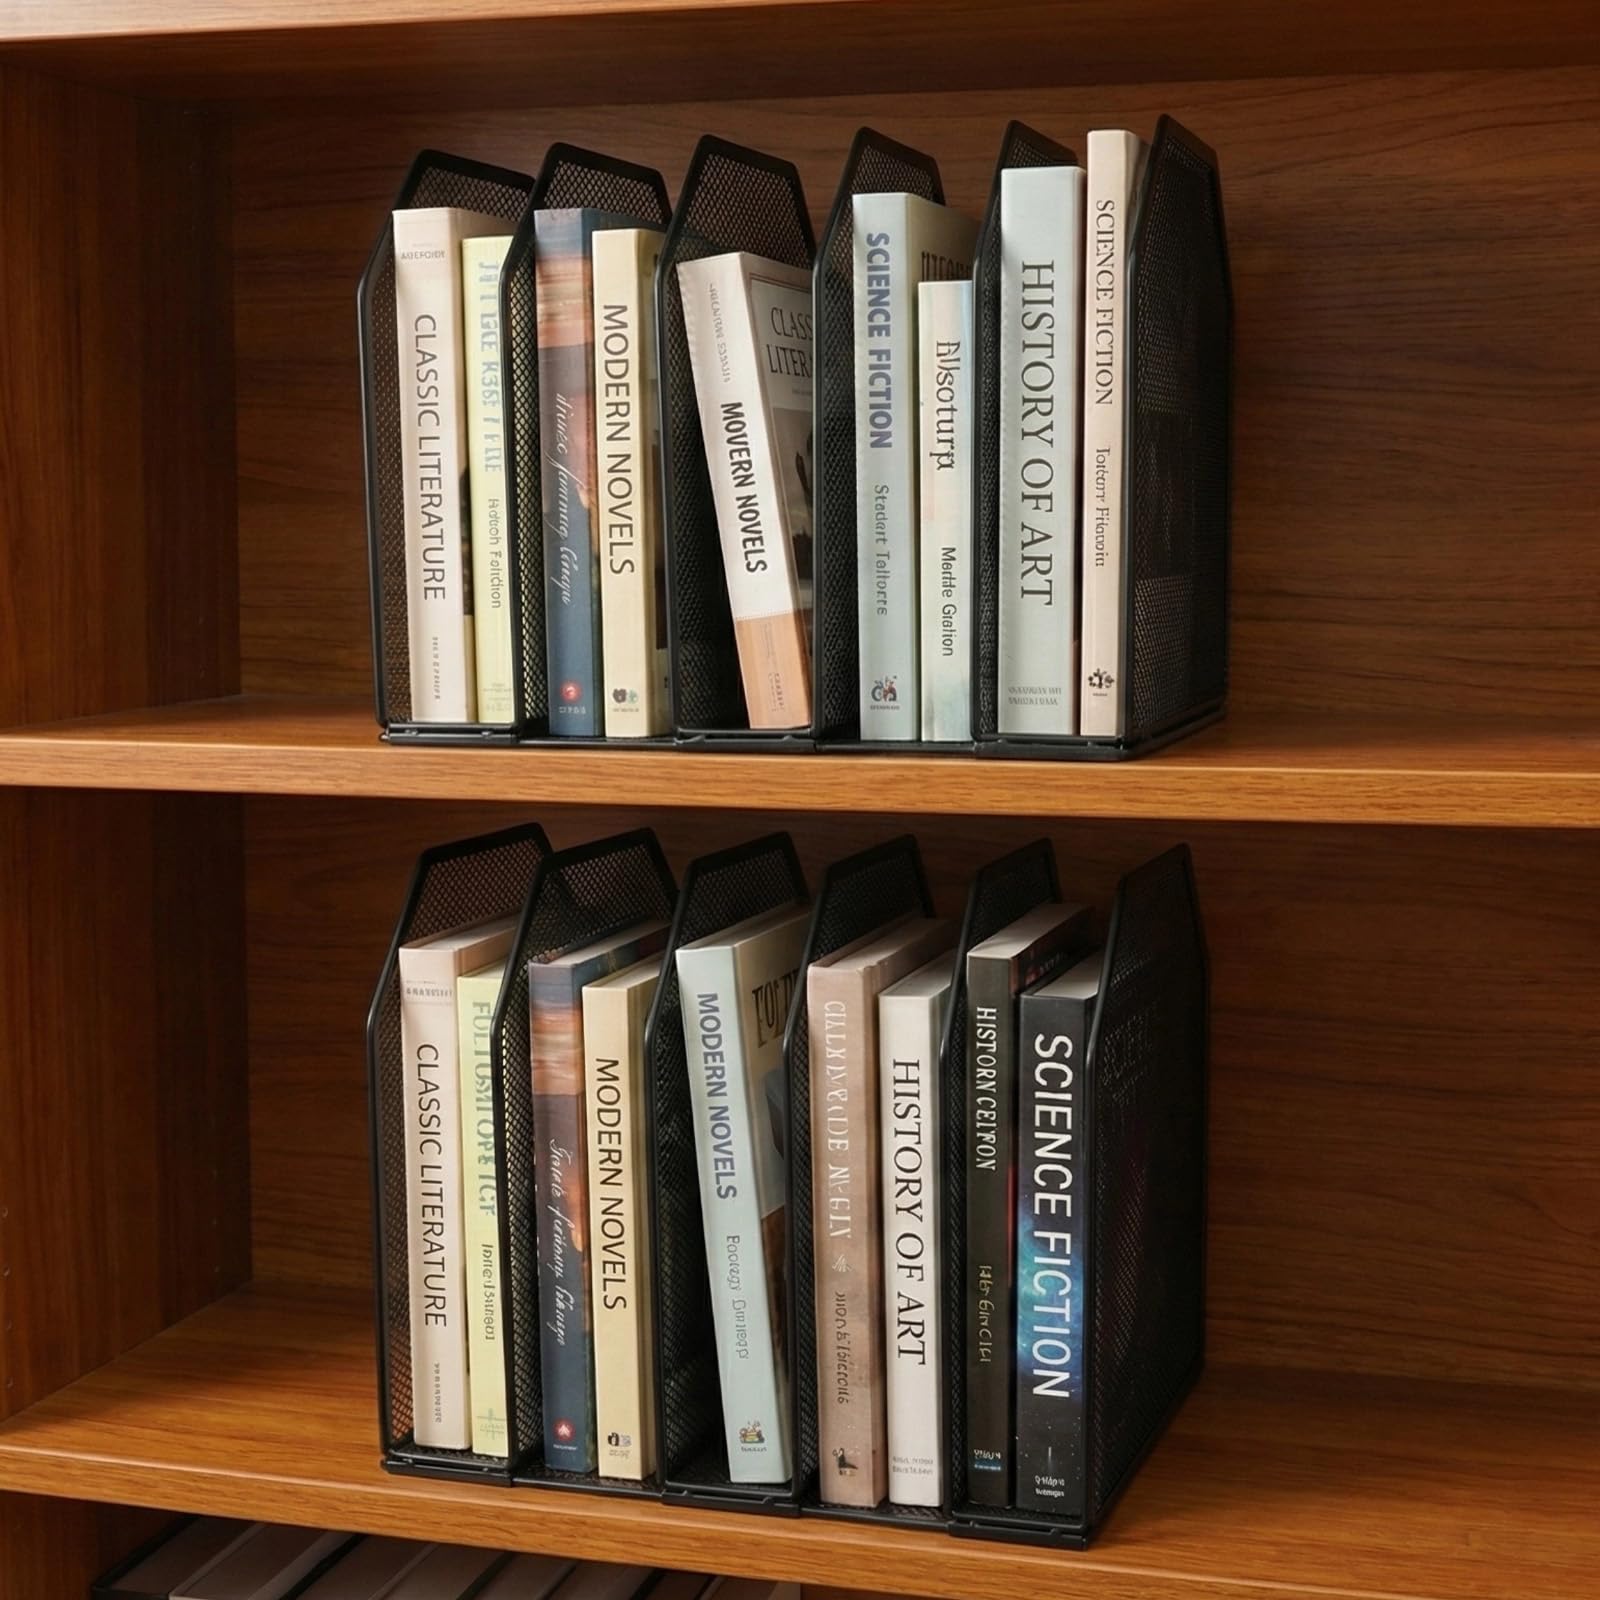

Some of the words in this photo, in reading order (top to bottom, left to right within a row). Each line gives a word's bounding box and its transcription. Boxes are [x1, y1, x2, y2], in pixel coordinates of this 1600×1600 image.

[868, 233, 891, 338] SCIENCE
[1096, 200, 1114, 300] SCIENCE
[415, 314, 442, 427] CLASSIC
[603, 305, 631, 441] MODERN
[869, 349, 892, 449] FICTION
[1021, 261, 1054, 448] HISTORY
[1096, 308, 1113, 405] FICTION
[721, 403, 755, 488] MOVERN
[1021, 457, 1053, 513] OF
[418, 435, 445, 600] LITERATURE
[607, 453, 634, 574] NOVELS
[735, 496, 767, 573] NOVELS
[1021, 524, 1052, 606] ART
[417, 1044, 442, 1155] CLASSIC
[697, 993, 728, 1098] MODERN
[596, 1059, 622, 1185] MODERN
[709, 1106, 736, 1199] NOVELS
[893, 1060, 923, 1222] HISTORY
[1033, 1034, 1072, 1217] SCIENCE
[420, 1164, 446, 1327] LITERATURE
[601, 1197, 626, 1310] NOVELS
[897, 1233, 924, 1282] OF
[897, 1292, 925, 1365] ART
[1033, 1230, 1070, 1397] FICTION
